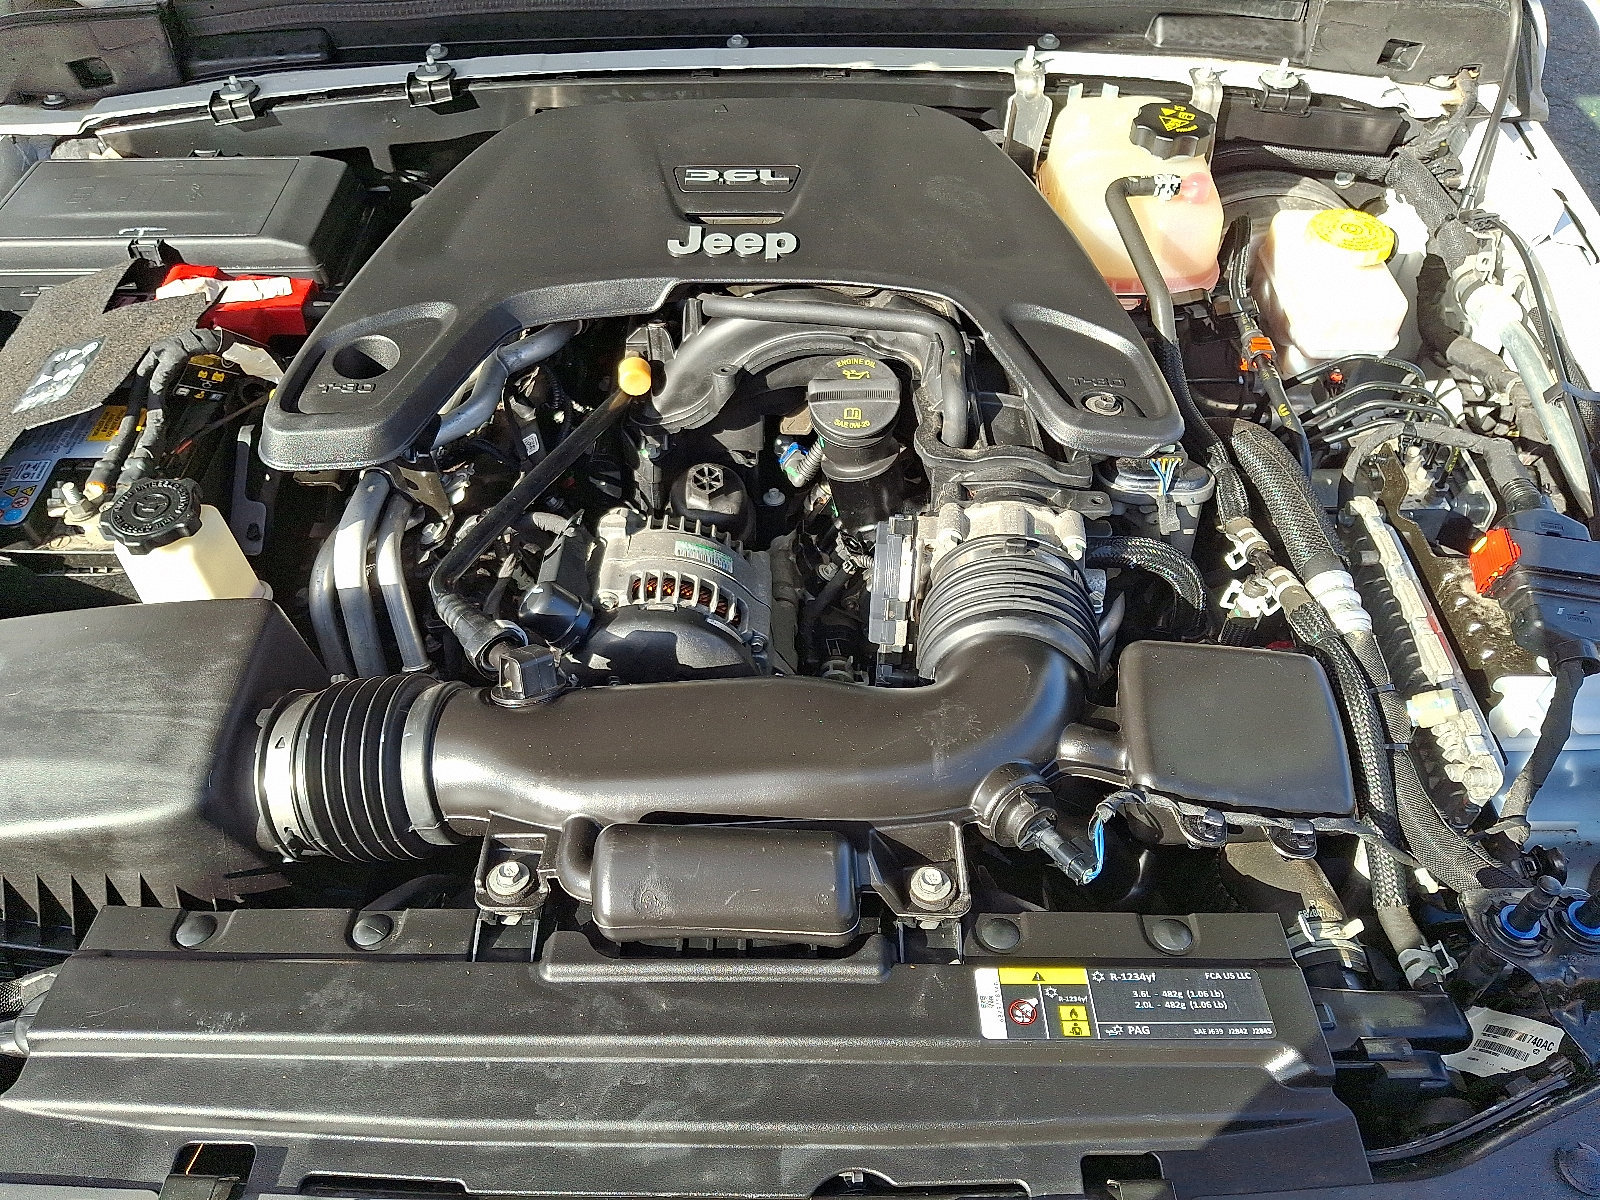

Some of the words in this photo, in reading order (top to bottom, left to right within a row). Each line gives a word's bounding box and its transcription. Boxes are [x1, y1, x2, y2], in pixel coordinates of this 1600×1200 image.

[685, 169, 790, 185] 3.6L
[667, 226, 797, 261] Jeep
[836, 358, 864, 368] ENGINE
[864, 358, 876, 369] OIL
[1109, 972, 1156, 983] R-1234yf
[1204, 972, 1222, 980] FCA
[1223, 972, 1235, 980] US
[1236, 972, 1252, 980] LLC
[1132, 990, 1151, 998] 3.6L
[1162, 990, 1184, 999] 482g
[1187, 989, 1209, 999] (1.06
[1134, 1001, 1155, 1009] 2.0L
[1164, 1001, 1187, 1010] 482g
[1190, 1000, 1212, 1010] (1.06
[1127, 1025, 1151, 1035] PAG
[1526, 1034, 1555, 1052] 740AC
